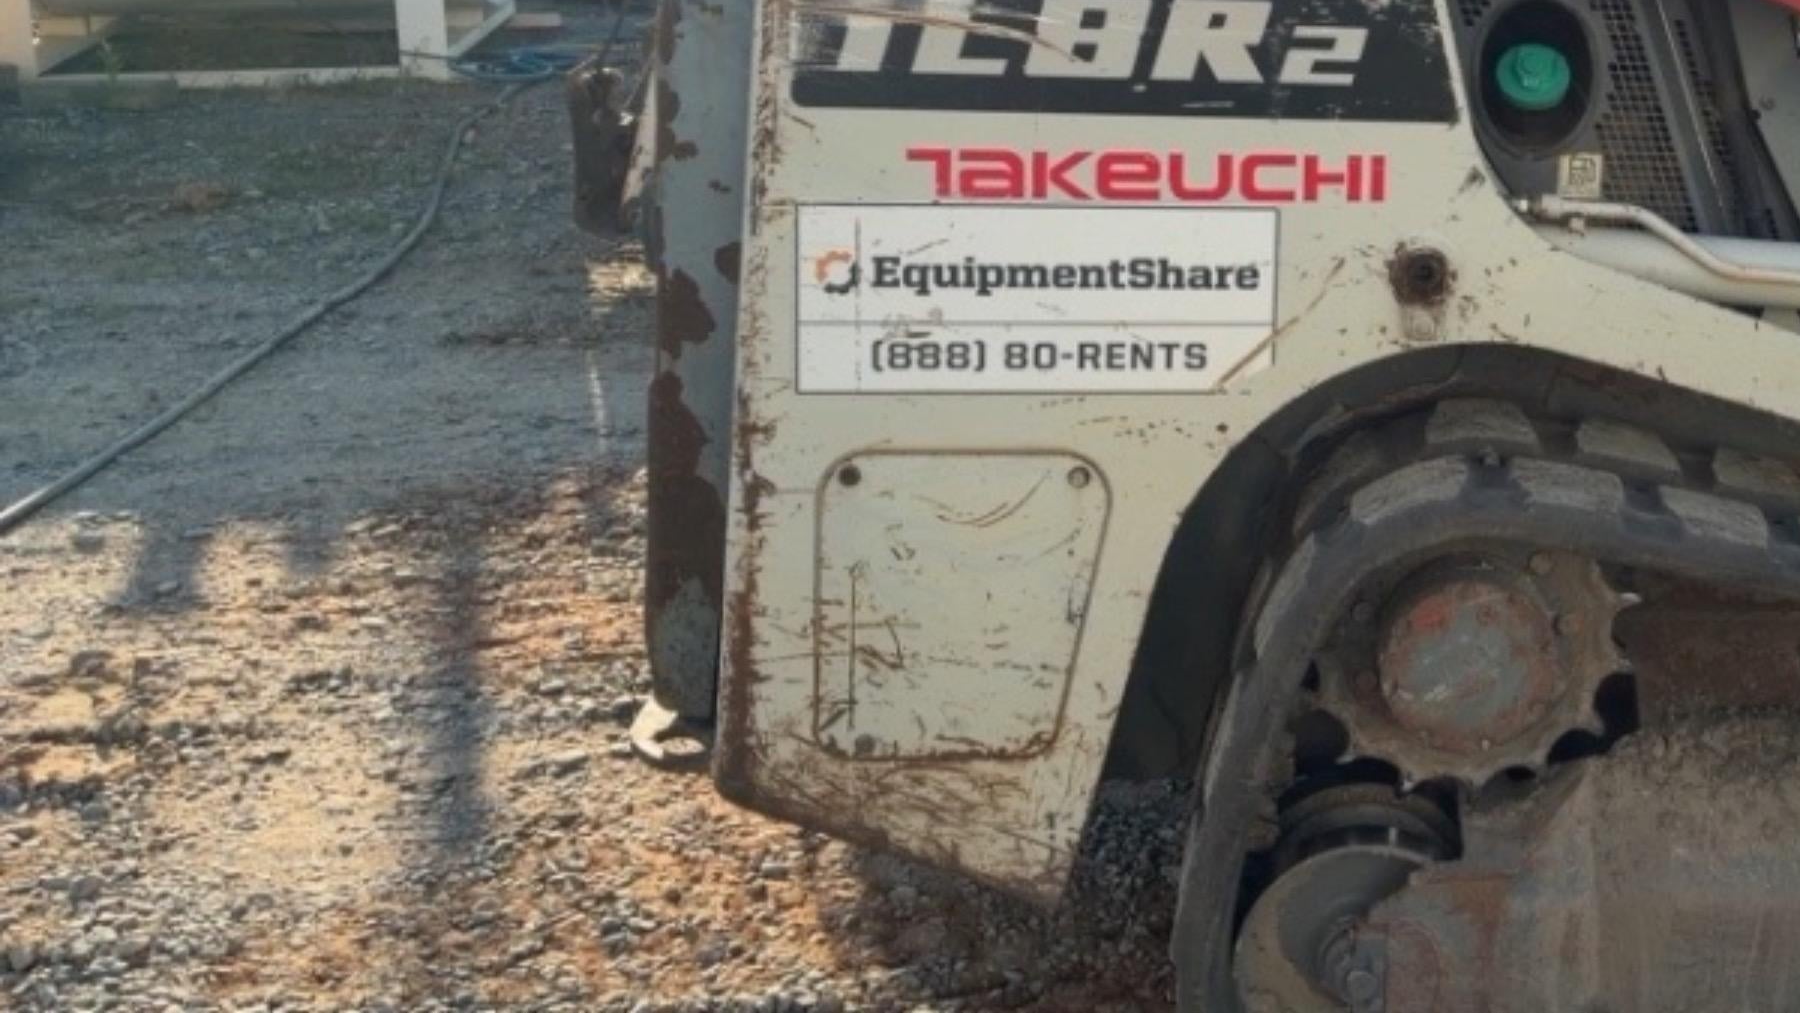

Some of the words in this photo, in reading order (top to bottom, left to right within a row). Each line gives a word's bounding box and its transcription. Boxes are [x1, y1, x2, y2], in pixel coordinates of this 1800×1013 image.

[870, 255, 1261, 297] EquipmentShare
[872, 339, 986, 373] (888)
[1003, 341, 1208, 371] 80-RENTS
